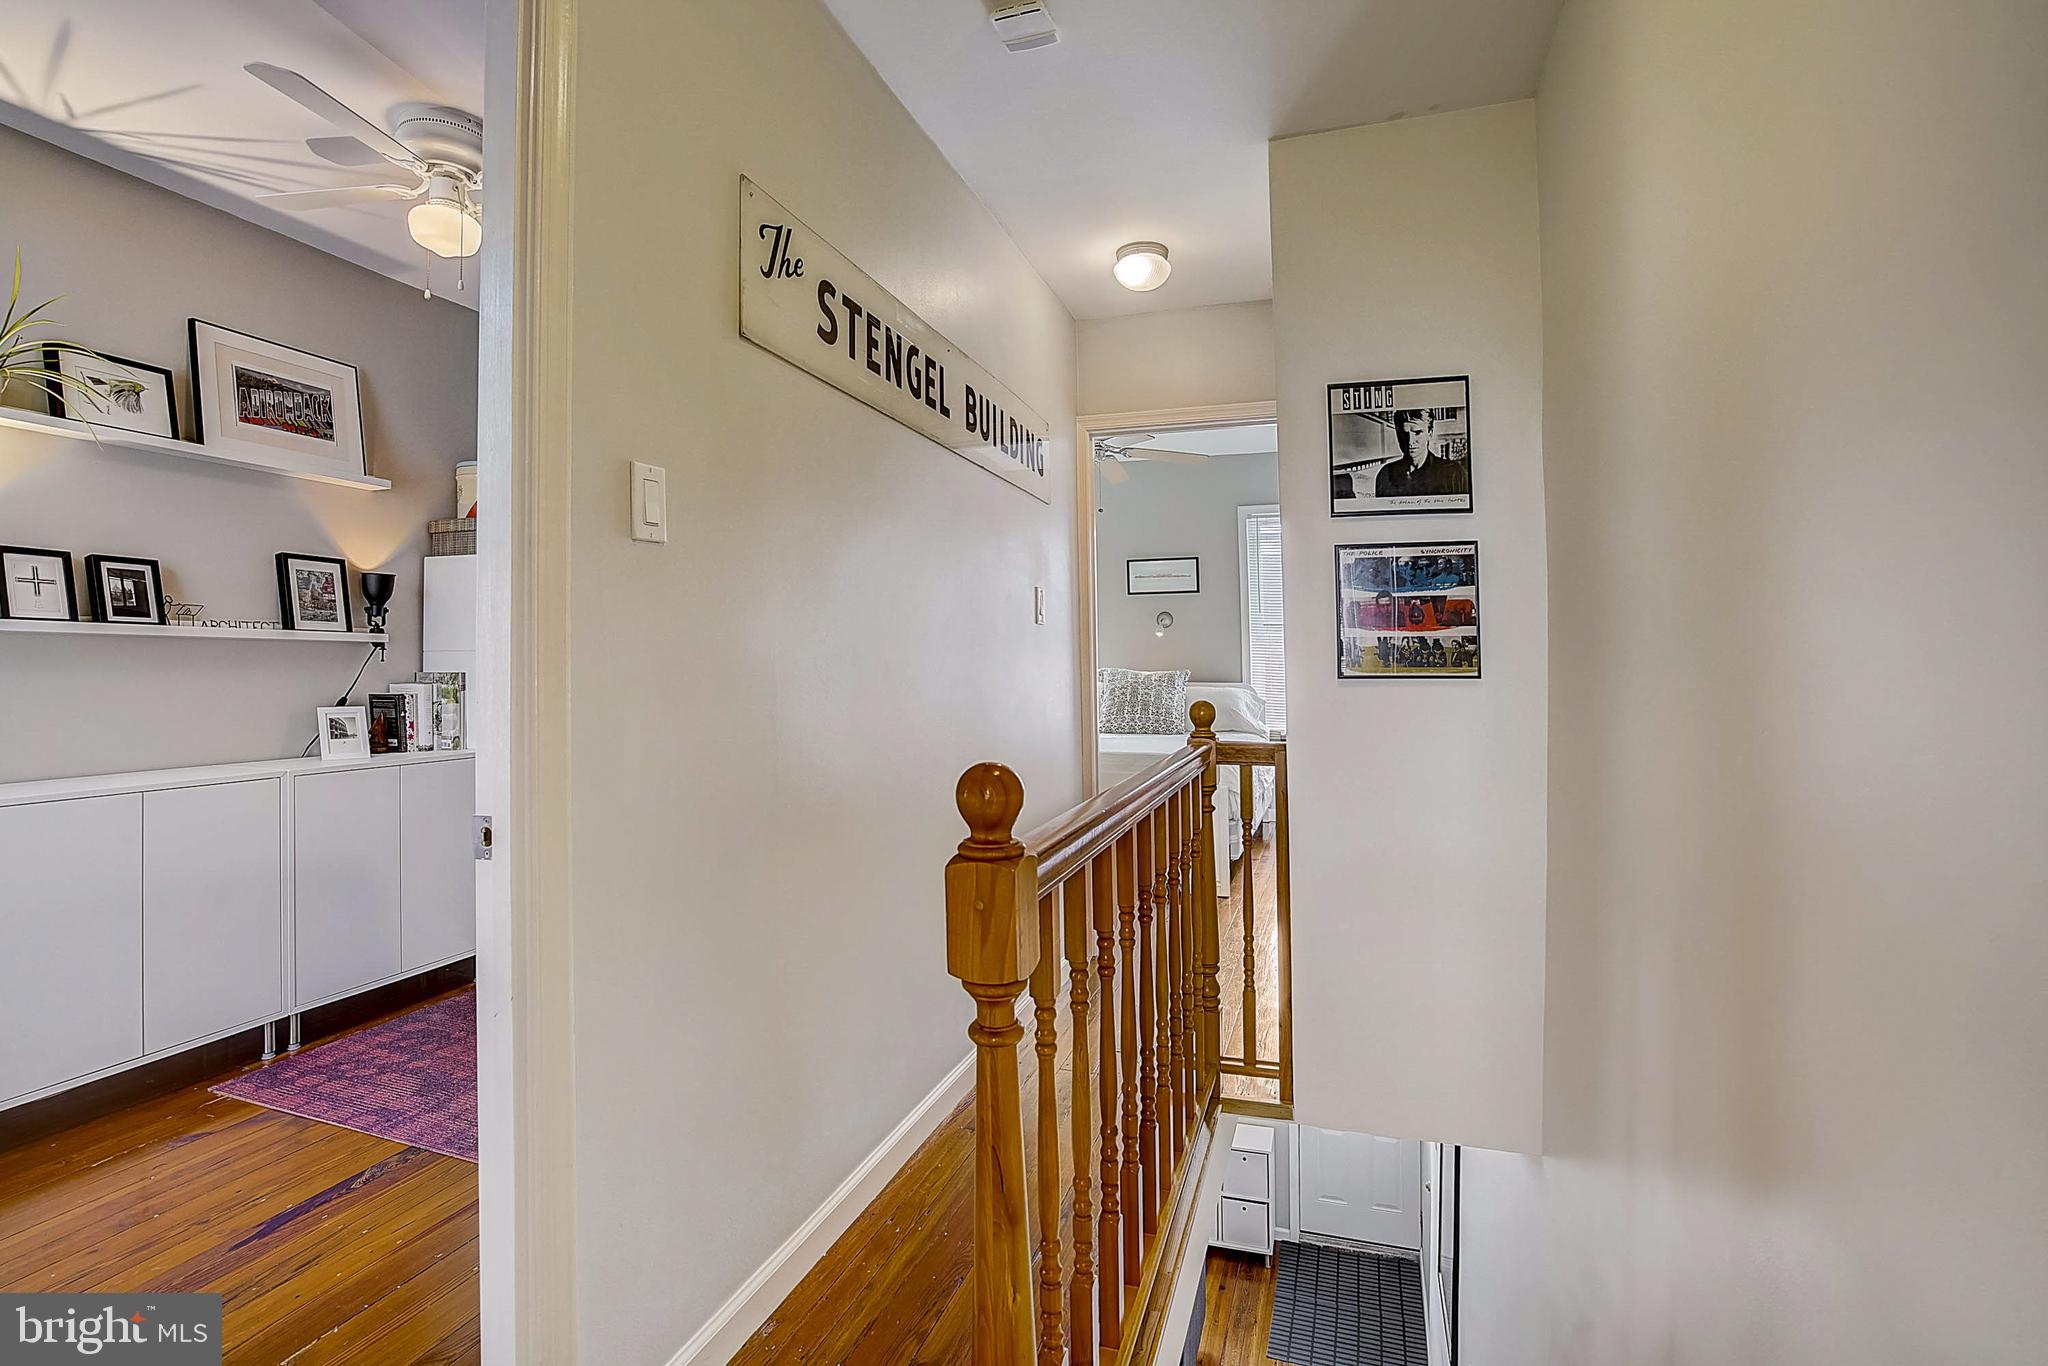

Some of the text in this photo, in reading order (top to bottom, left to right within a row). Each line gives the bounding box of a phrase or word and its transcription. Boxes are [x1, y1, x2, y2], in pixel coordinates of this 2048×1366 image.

[758, 223, 1044, 477] The STENGEL BUILDING
[239, 387, 334, 423] ADIRONDACK
[1343, 389, 1393, 409] STING
[1420, 547, 1473, 555] SYNCHRONICITY
